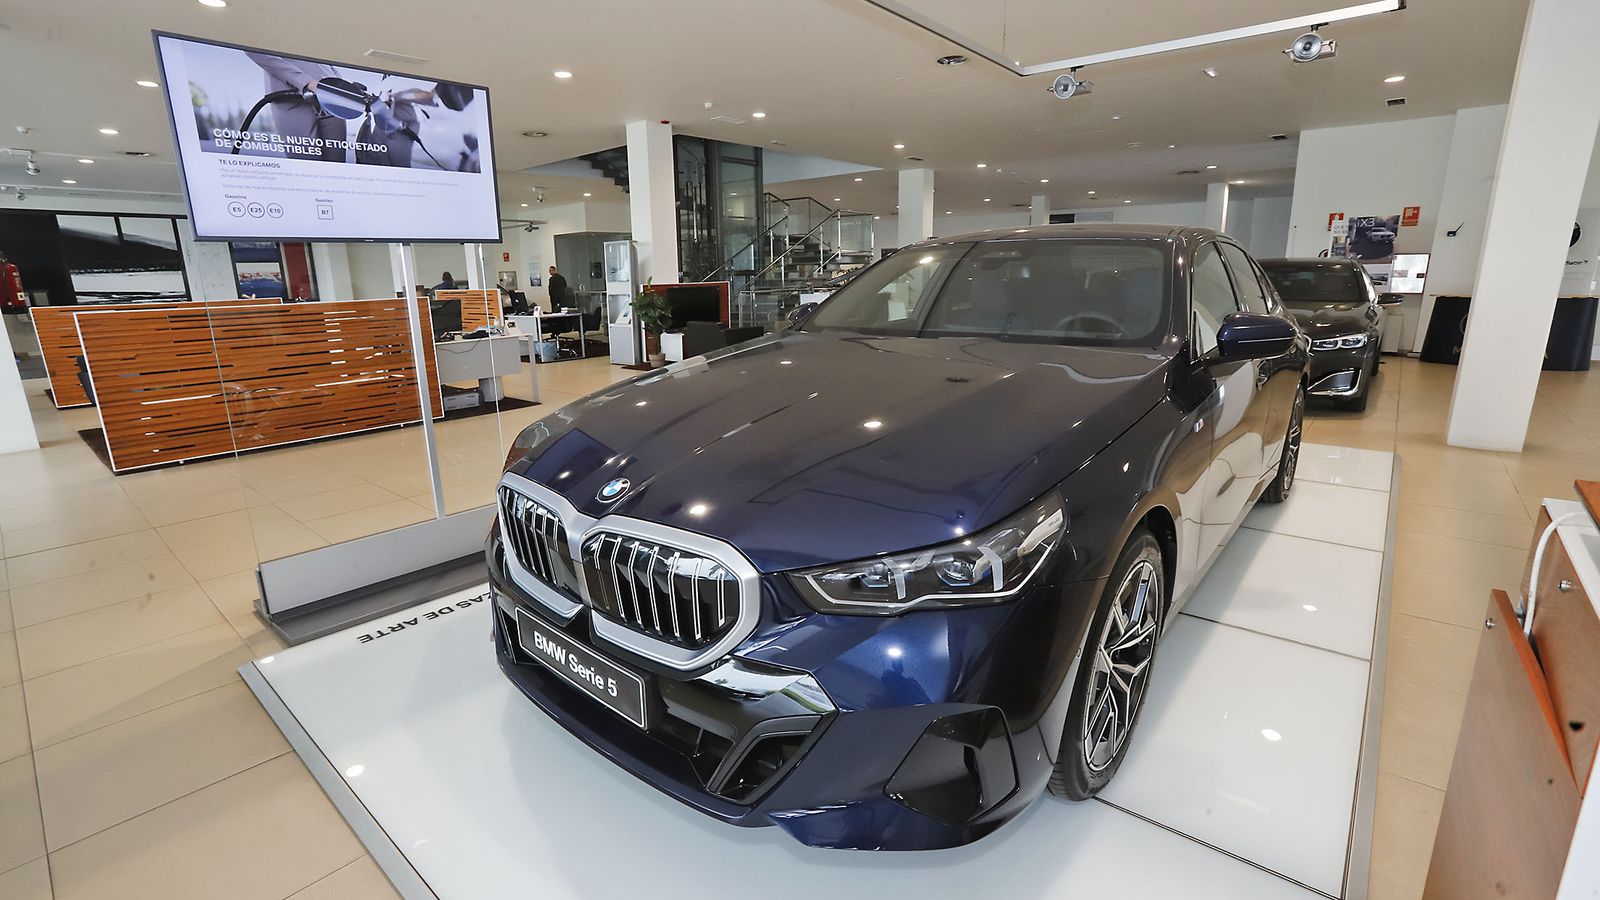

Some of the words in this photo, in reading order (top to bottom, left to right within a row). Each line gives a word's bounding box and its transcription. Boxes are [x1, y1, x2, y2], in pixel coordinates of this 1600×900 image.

[213, 128, 251, 140] CÓMO
[253, 132, 269, 142] ES
[271, 134, 285, 144] EL
[286, 135, 324, 147] NUEVO
[325, 139, 388, 153] ETIQUETADO
[215, 138, 232, 148] DE
[234, 140, 323, 156] COMBUSTIBLES
[239, 160, 281, 169] EXPLICAMOS
[269, 207, 282, 215] E10
[423, 606, 455, 621] DE
[356, 617, 419, 644] ARTE
[533, 630, 567, 667] BMW
[568, 652, 606, 691] Serie
[607, 676, 619, 698] 5
